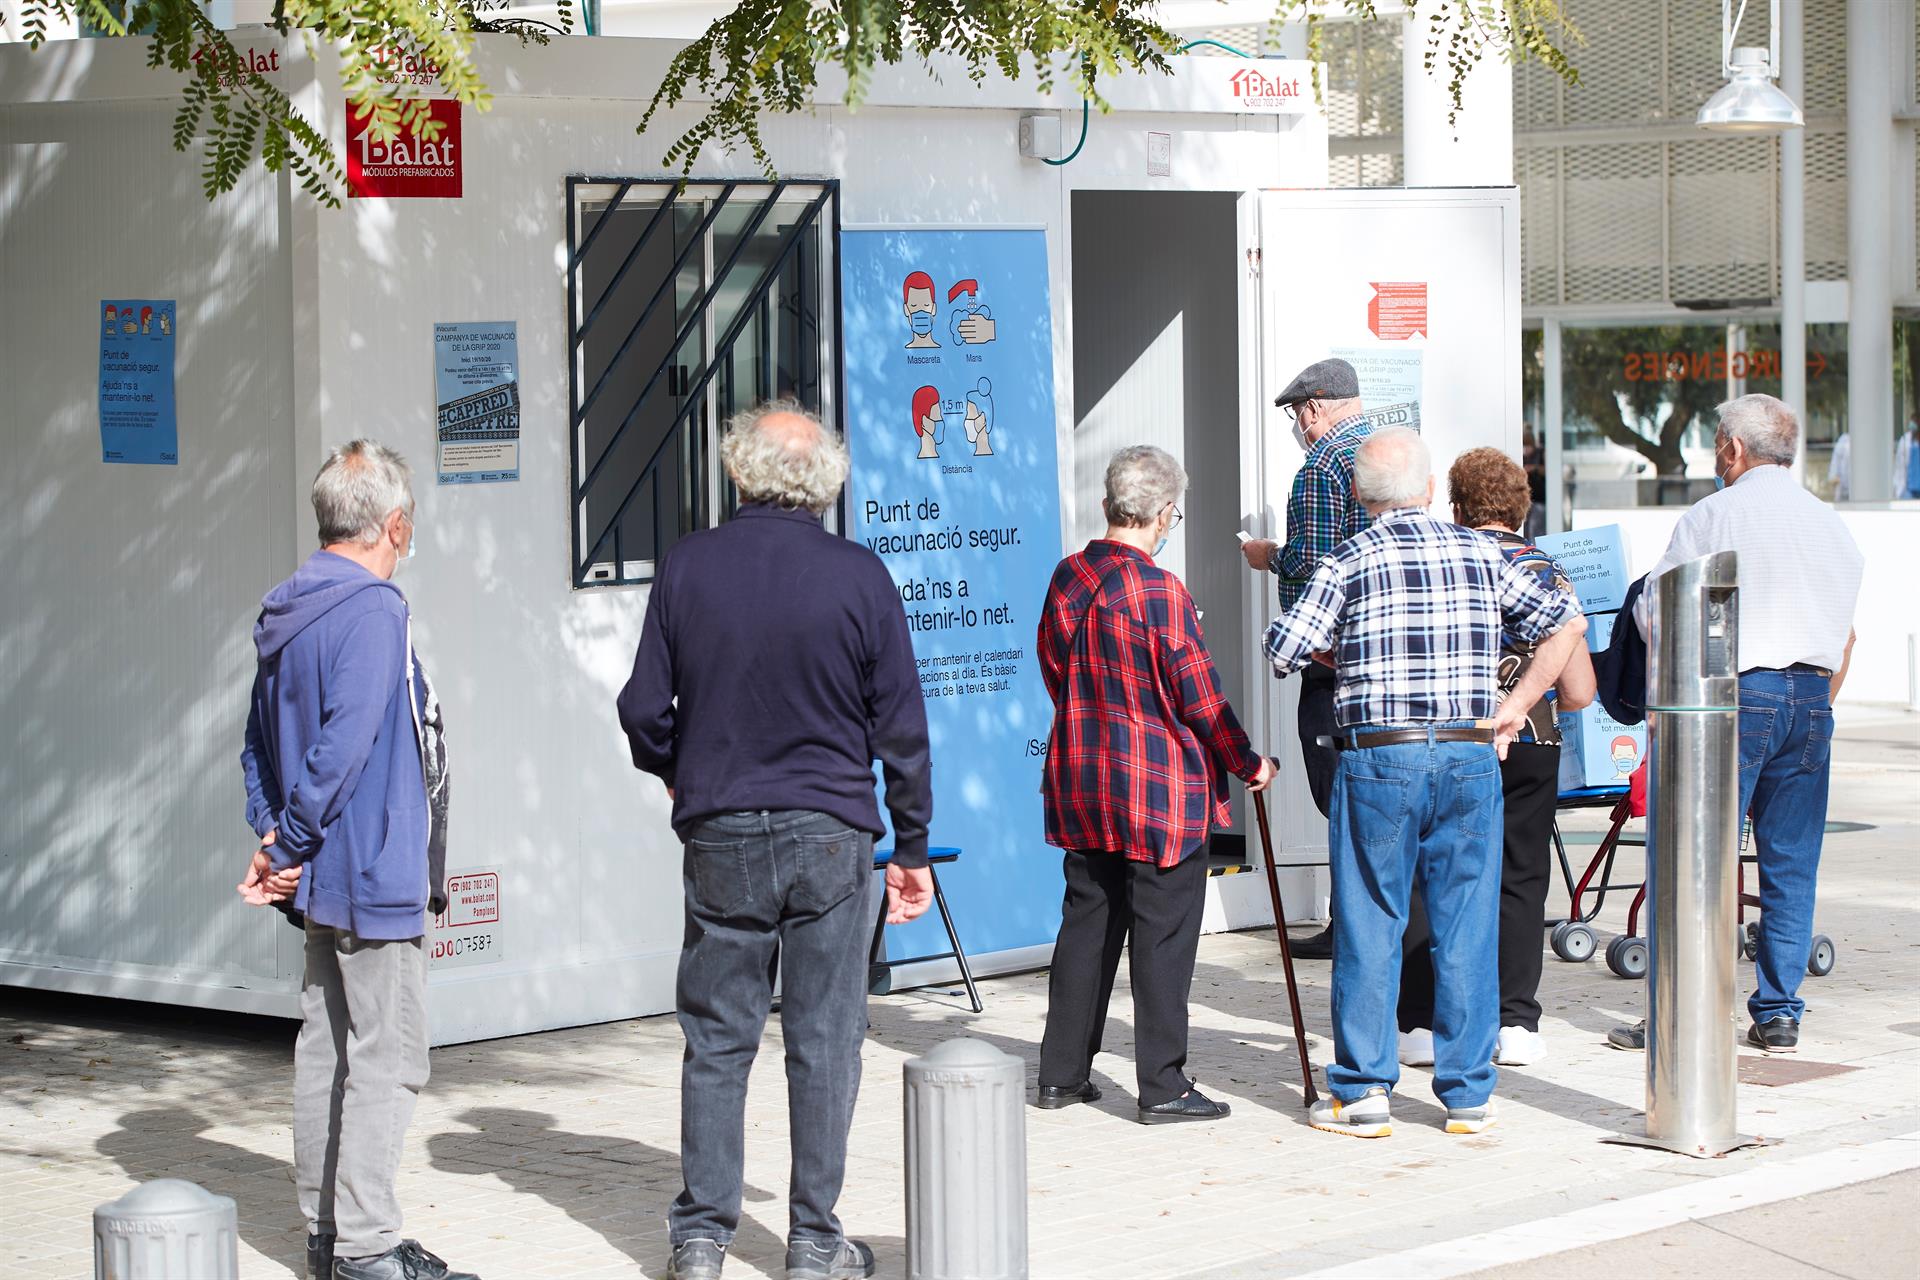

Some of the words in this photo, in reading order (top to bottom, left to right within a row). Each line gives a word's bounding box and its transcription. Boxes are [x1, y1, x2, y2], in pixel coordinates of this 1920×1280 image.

[1241, 69, 1299, 97] Balat
[353, 127, 455, 166] Balat
[361, 166, 398, 178] MÓDULOS
[398, 167, 455, 178] PREFABRICADOS
[436, 334, 469, 343] CAMPANYA
[470, 334, 479, 342] DE
[480, 332, 516, 341] VACUNACIÓ
[104, 350, 119, 360] Punt
[120, 350, 129, 360] de
[452, 344, 461, 352] DE
[462, 344, 470, 352] LA
[471, 343, 486, 351] GRIP
[487, 343, 501, 351] 2020
[907, 355, 941, 365] Mascareta
[966, 354, 983, 363] Mans
[438, 391, 508, 428] #CAPFRED
[942, 399, 954, 412] 1,5
[954, 401, 964, 410] m
[1367, 409, 1408, 428] FRED
[942, 464, 973, 475] Distància
[865, 499, 911, 524] Punt
[917, 497, 940, 520] de
[867, 525, 963, 554] vacunació
[969, 526, 1021, 552] segur.
[1563, 540, 1581, 550] Punt
[1583, 539, 1593, 547] de
[1551, 547, 1587, 560] acunació
[1588, 544, 1611, 555] segur.
[1570, 572, 1596, 583] tenir-lo
[1598, 569, 1612, 579] net.
[899, 577, 952, 602] da'ns
[957, 579, 969, 598] a
[906, 605, 977, 632] ntenir-lo
[983, 603, 1014, 624] net.
[933, 652, 971, 667] mantenir
[973, 651, 982, 663] el
[984, 647, 1023, 662] calendari
[920, 670, 949, 683] acions
[951, 669, 960, 680] al
[961, 666, 979, 679] dia.
[981, 663, 993, 677] És
[995, 662, 1017, 676] bàsic
[942, 684, 954, 696] de
[956, 683, 964, 695] la
[966, 683, 986, 694] teva
[987, 679, 1011, 692] salut.
[1025, 738, 1047, 757] /Sa
[461, 893, 495, 905] www.balat.com
[473, 906, 495, 917] Pamplona
